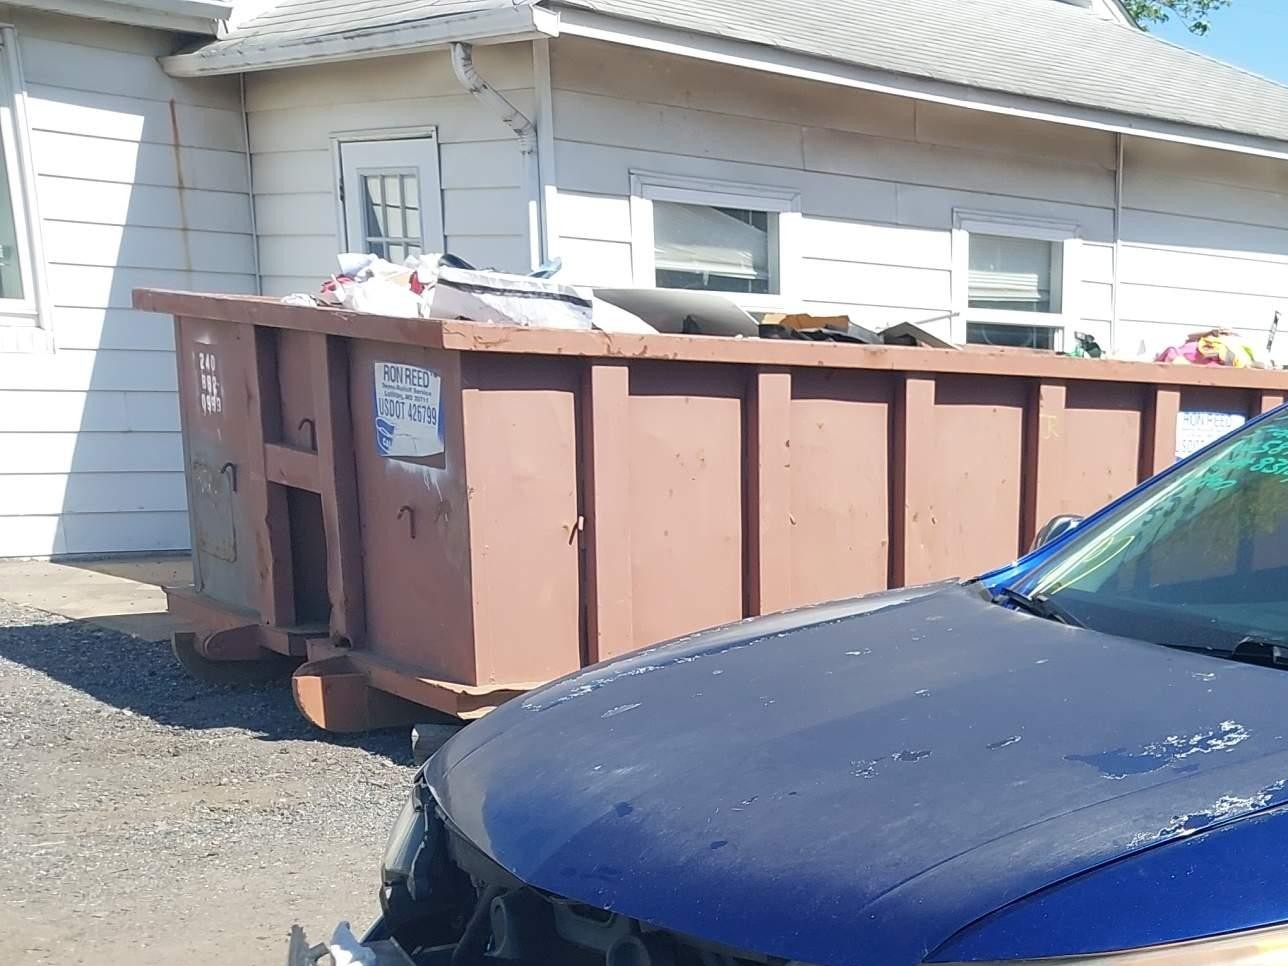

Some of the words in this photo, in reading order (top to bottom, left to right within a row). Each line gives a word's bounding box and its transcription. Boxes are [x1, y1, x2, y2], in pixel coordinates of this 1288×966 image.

[383, 364, 403, 384] RON
[404, 367, 430, 389] REED
[378, 397, 405, 419] USDOT
[407, 403, 438, 426] 426799
